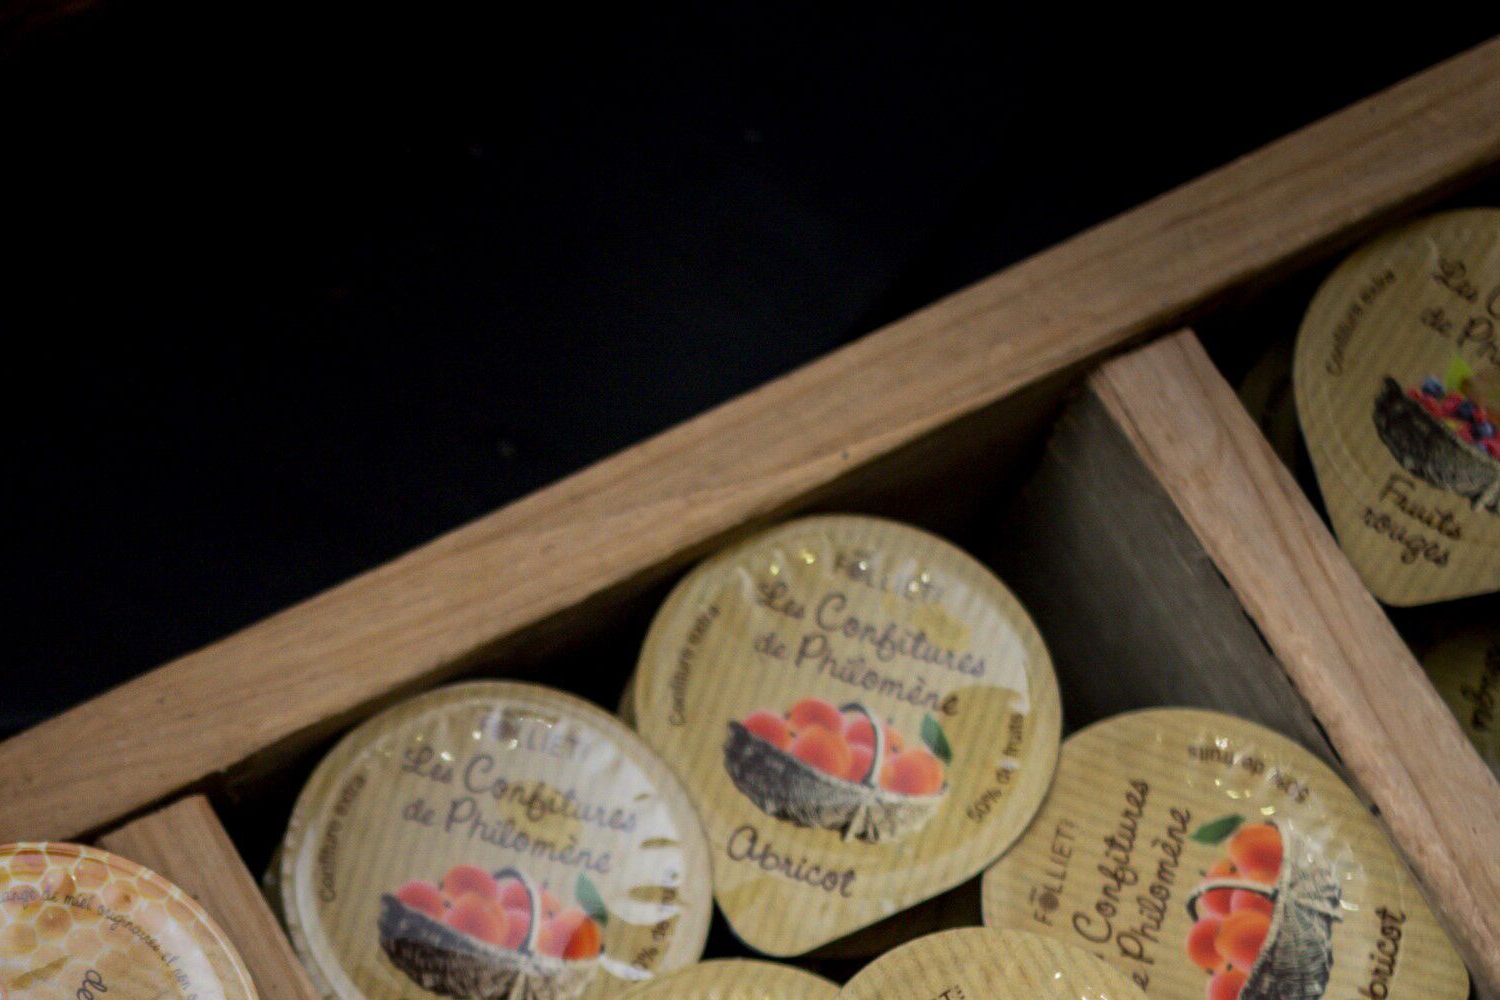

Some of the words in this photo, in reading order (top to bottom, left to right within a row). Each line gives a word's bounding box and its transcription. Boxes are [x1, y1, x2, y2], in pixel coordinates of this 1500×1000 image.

[1364, 507, 1449, 566] rouges
[1379, 473, 1462, 540] Fruits
[757, 579, 805, 620] Les
[816, 592, 986, 678] Confitures
[754, 632, 786, 659] de
[796, 634, 959, 714] Philomène
[402, 746, 453, 784] Les
[464, 753, 638, 833] Confitures
[404, 800, 435, 827] de
[444, 798, 612, 874] Philomène
[727, 824, 857, 897] Abricot
[1072, 778, 1149, 944] Confitures
[1116, 806, 1192, 966] Philomène
